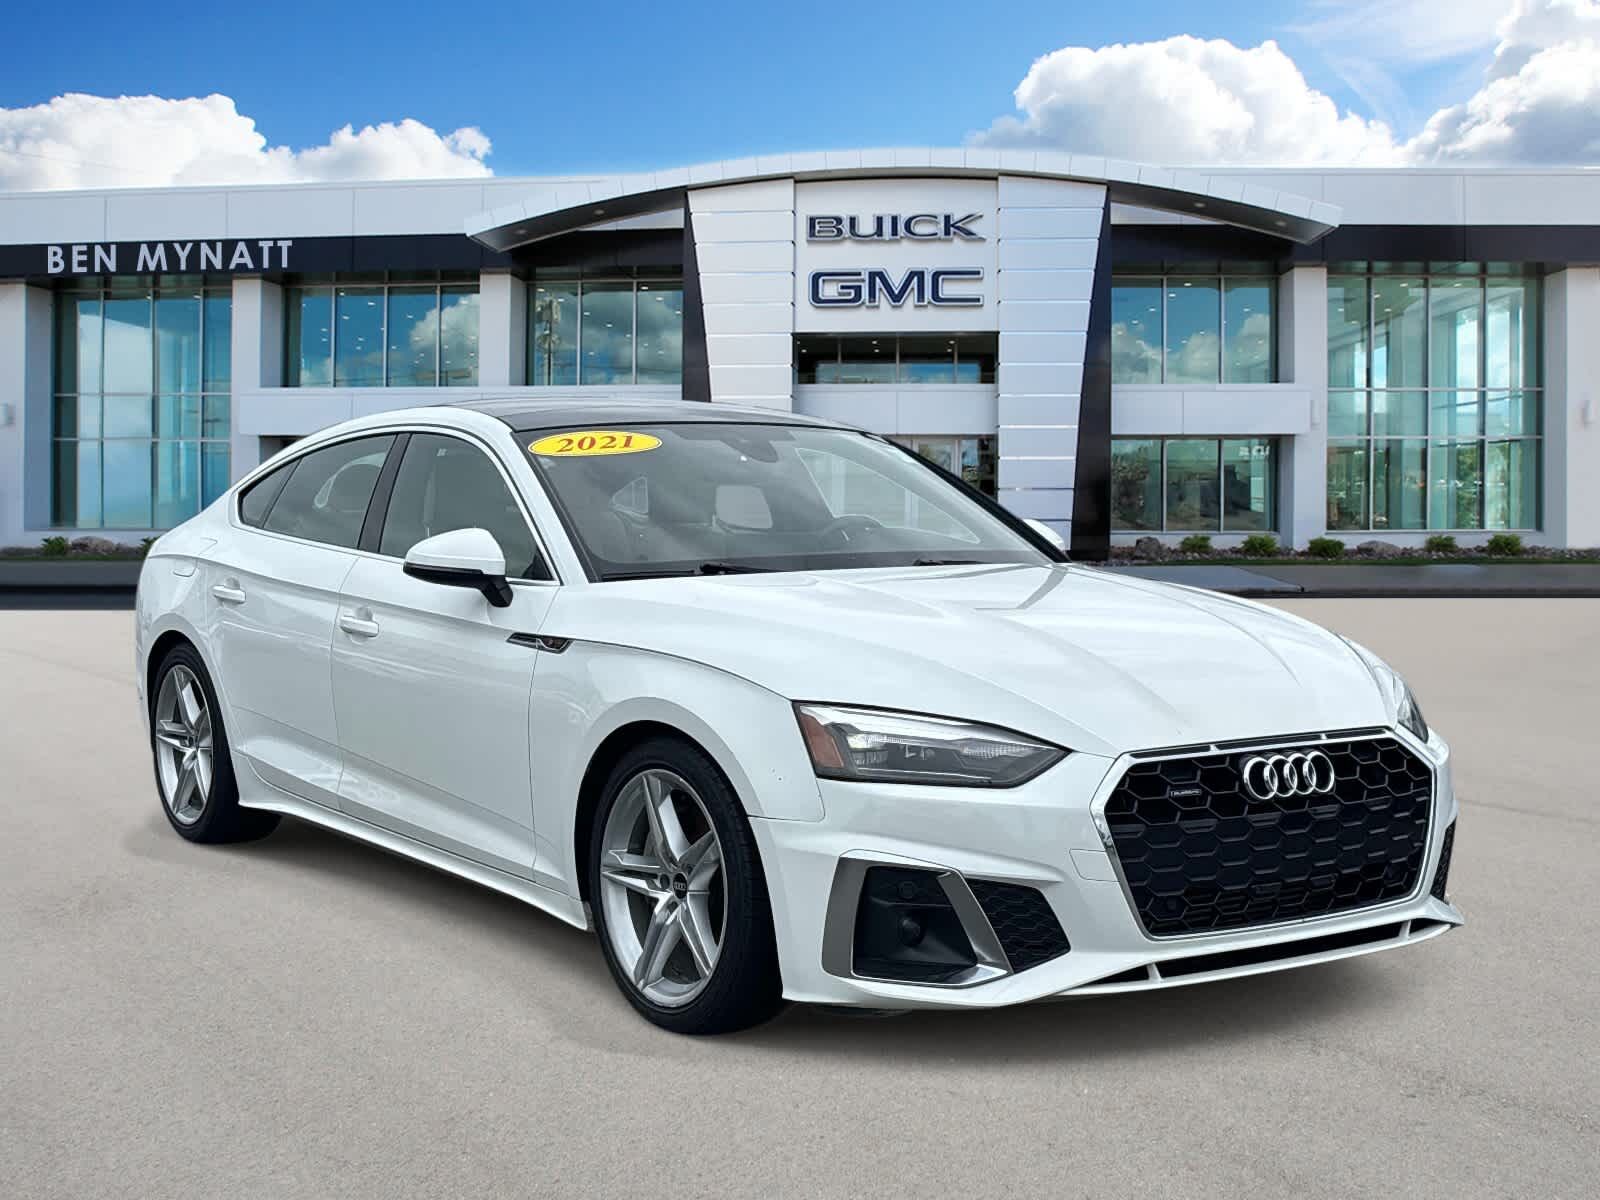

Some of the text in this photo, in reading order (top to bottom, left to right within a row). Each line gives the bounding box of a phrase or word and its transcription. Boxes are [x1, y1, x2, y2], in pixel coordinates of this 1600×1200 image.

[807, 212, 984, 242] BUICK
[47, 240, 293, 274] BEN MYNATT
[808, 267, 984, 308] GMC
[556, 435, 633, 453] 2021
